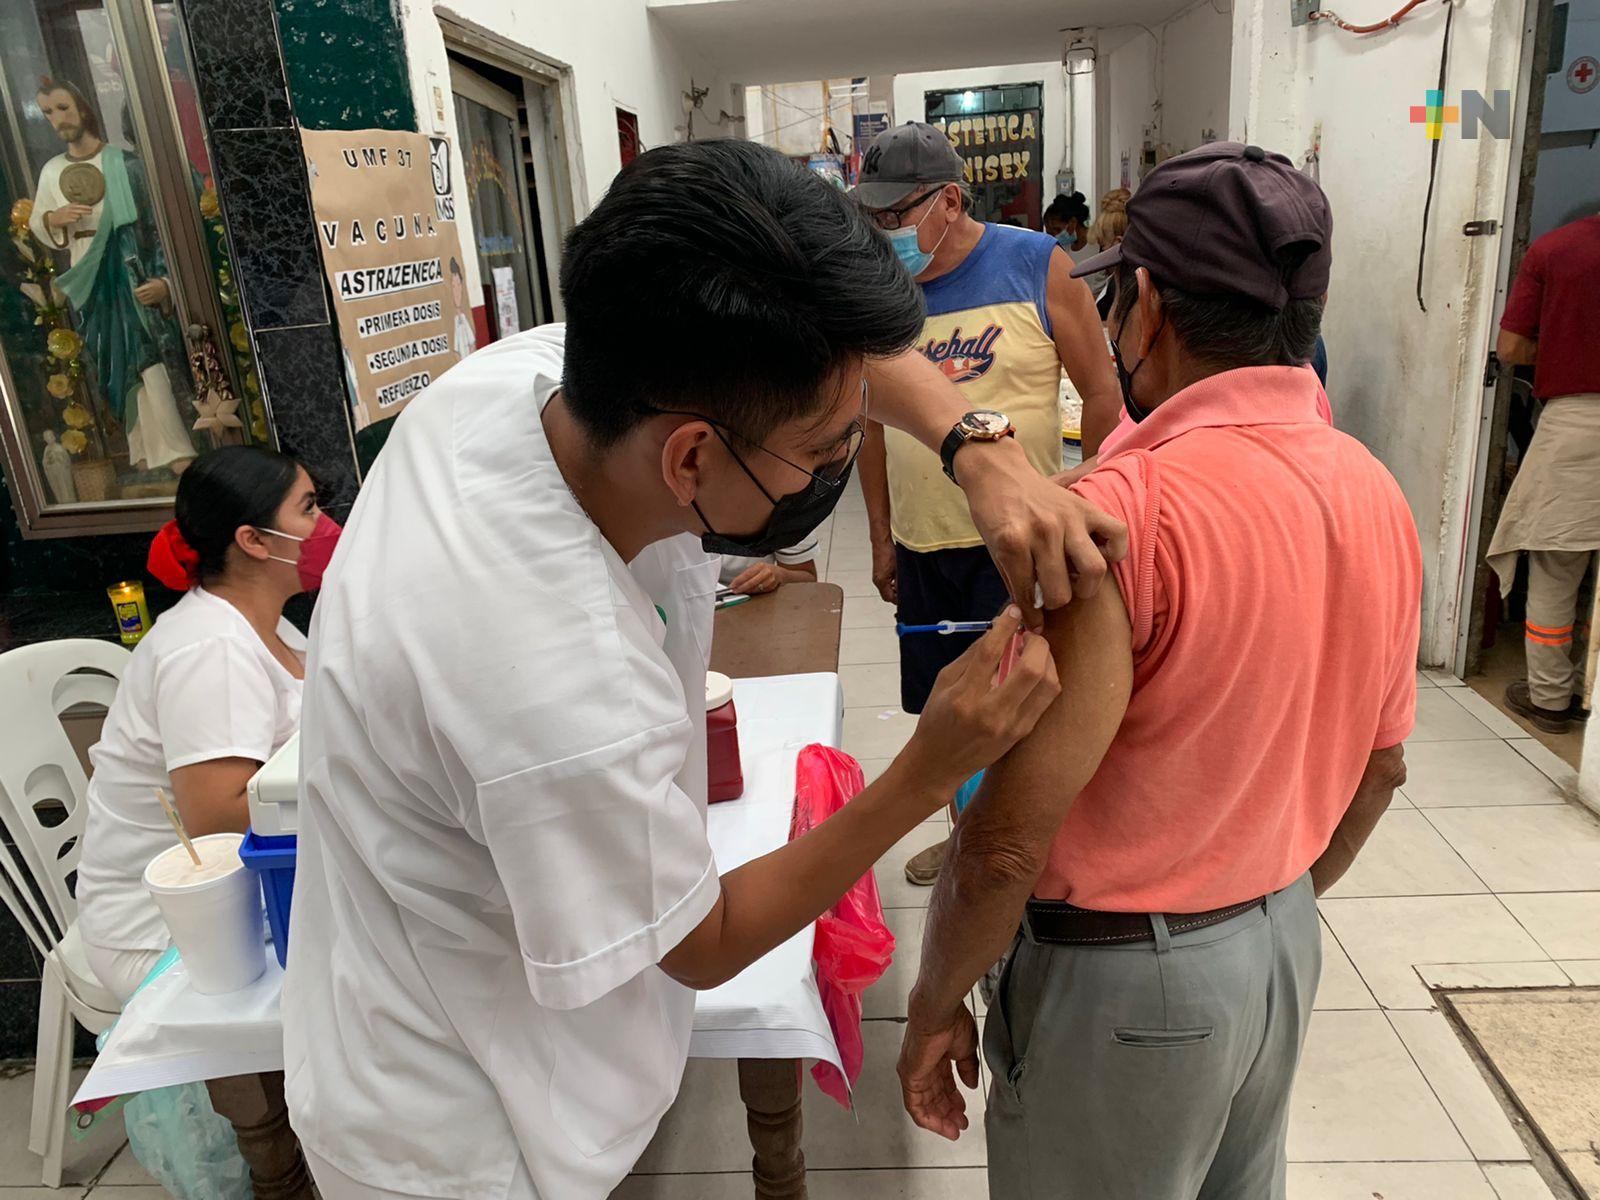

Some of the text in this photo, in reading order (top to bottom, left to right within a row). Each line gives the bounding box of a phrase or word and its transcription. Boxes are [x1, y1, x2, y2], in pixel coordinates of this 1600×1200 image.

[342, 148, 411, 168] UMF 37
[963, 151, 1030, 182] NISEX
[322, 214, 436, 247] VACUNA
[341, 259, 443, 296] ASTRAZENECA
[413, 302, 440, 322] DOSIS
[422, 335, 448, 355] DOSIS
[382, 373, 430, 405] REFUERZO
